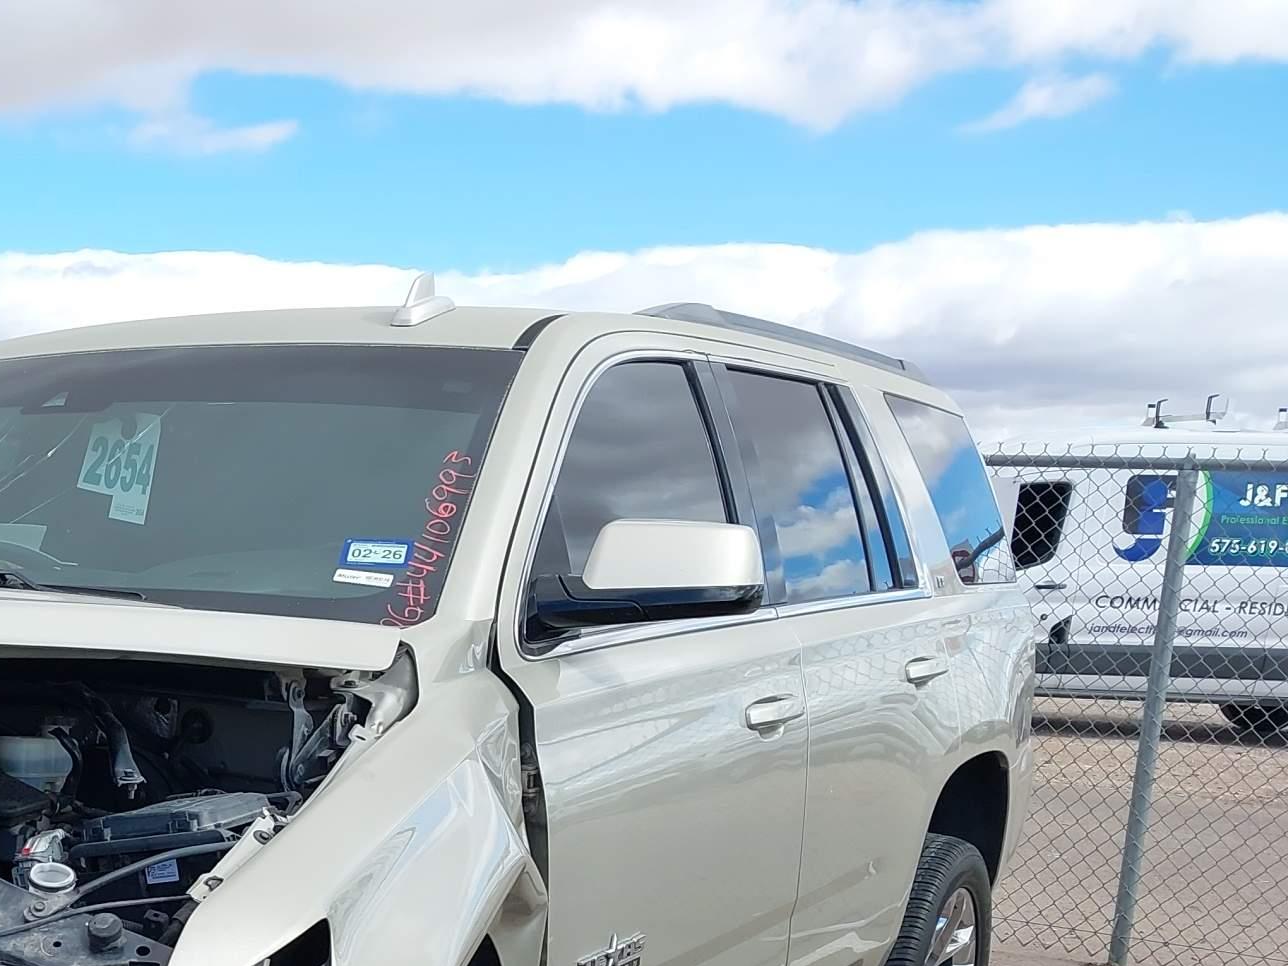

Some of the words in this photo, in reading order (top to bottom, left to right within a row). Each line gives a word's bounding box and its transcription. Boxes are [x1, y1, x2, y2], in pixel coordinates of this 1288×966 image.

[82, 436, 155, 495] 2654
[1239, 483, 1288, 507] J&F
[1220, 514, 1280, 525] Professional
[1209, 538, 1288, 554] 575-619-
[1095, 594, 1219, 614] COMMCIAL
